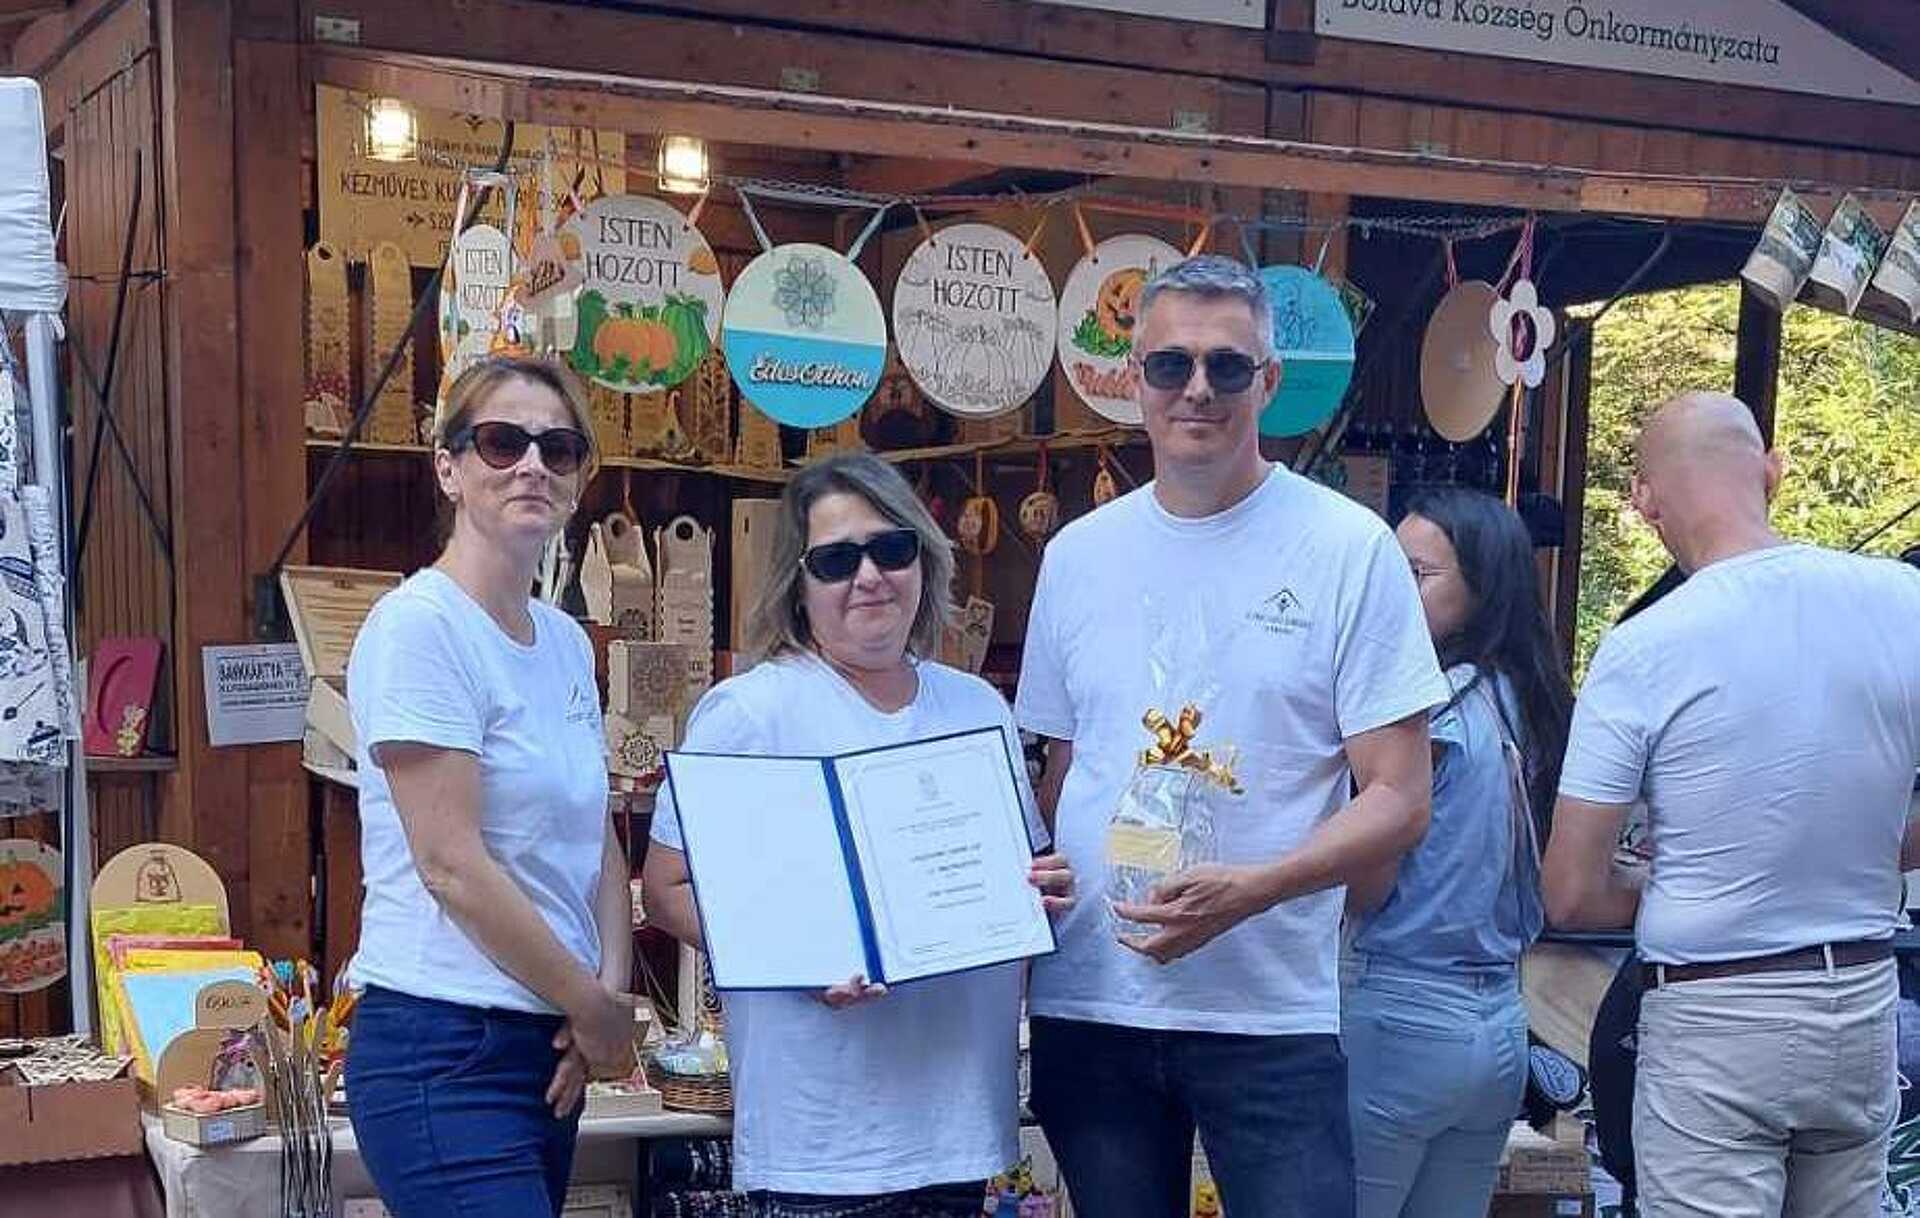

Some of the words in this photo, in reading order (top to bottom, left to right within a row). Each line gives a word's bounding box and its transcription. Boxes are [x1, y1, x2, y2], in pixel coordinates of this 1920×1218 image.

[1564, 0, 1780, 65] Önkormányzata
[599, 215, 674, 250] ISTEN
[586, 251, 682, 288] HOZOTT
[946, 243, 1014, 278] ISTEN
[933, 278, 1024, 313] HOZOTT
